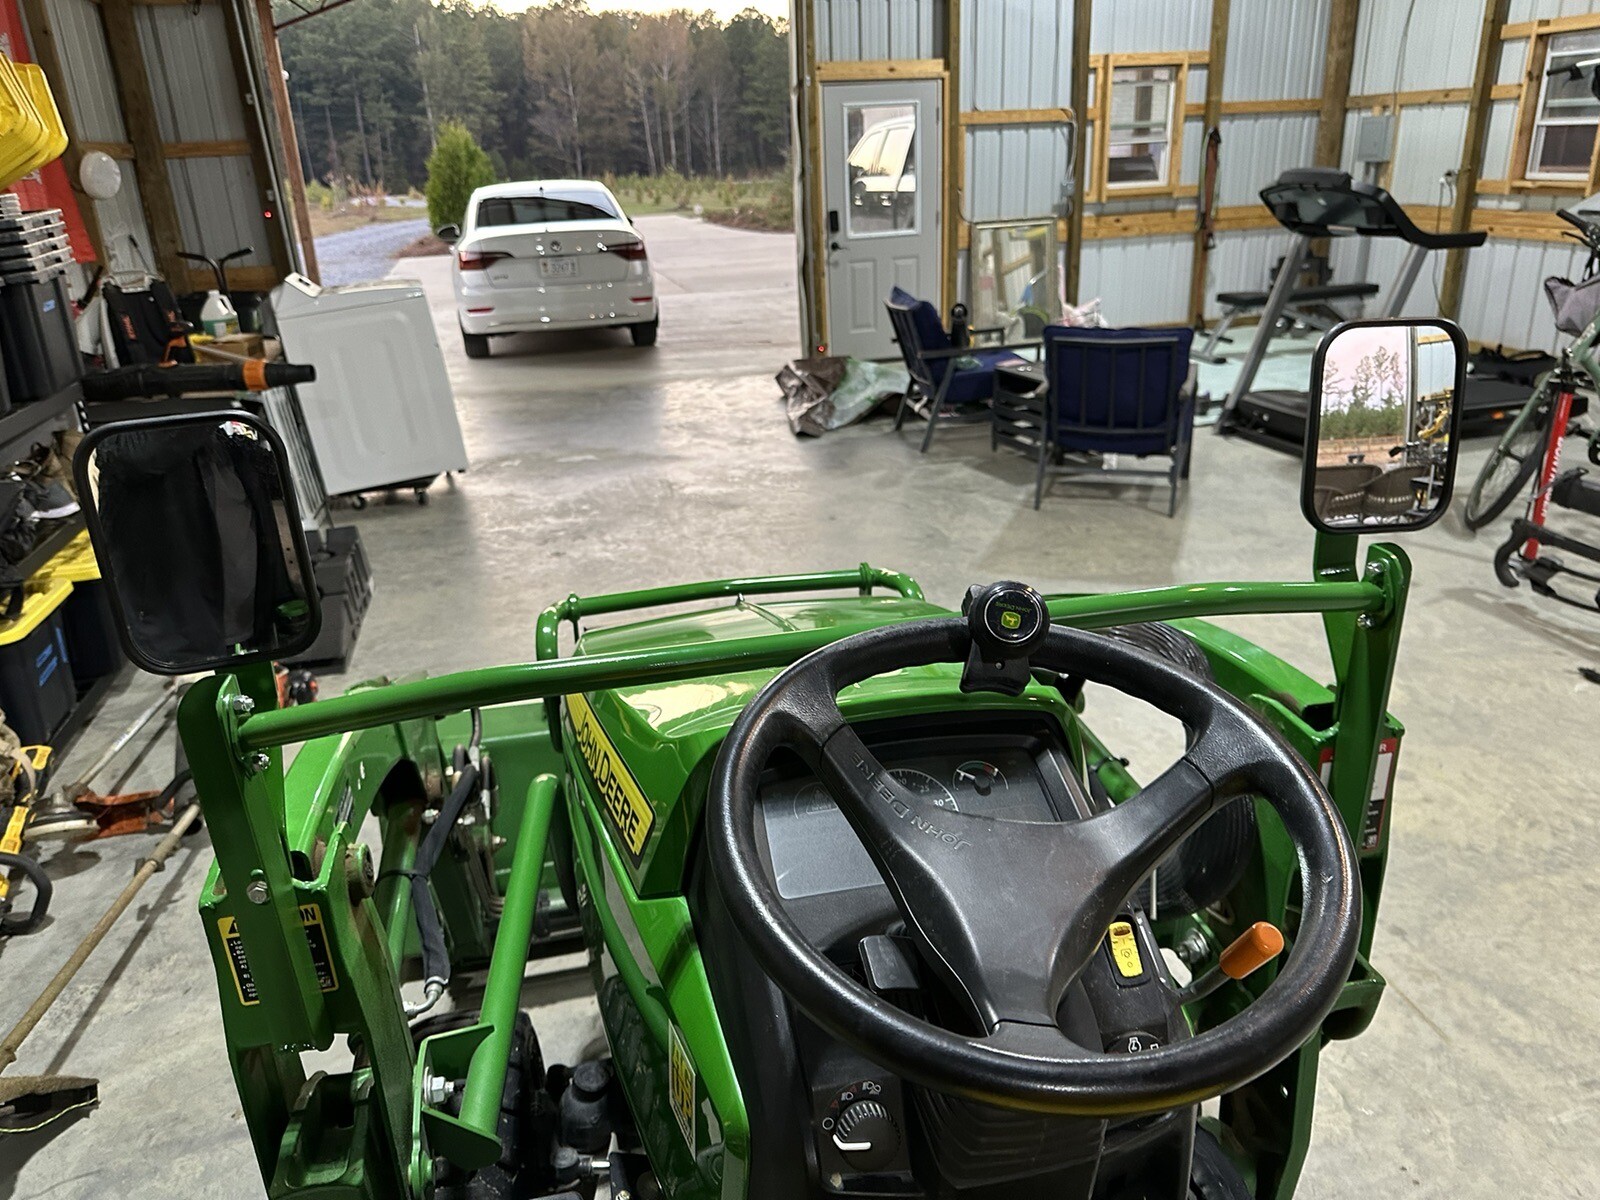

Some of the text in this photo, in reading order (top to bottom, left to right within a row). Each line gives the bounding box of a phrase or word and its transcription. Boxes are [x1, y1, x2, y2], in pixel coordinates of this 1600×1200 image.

[576, 711, 640, 847] JOHN DEERE
[851, 750, 971, 850] JOHN DEERE
